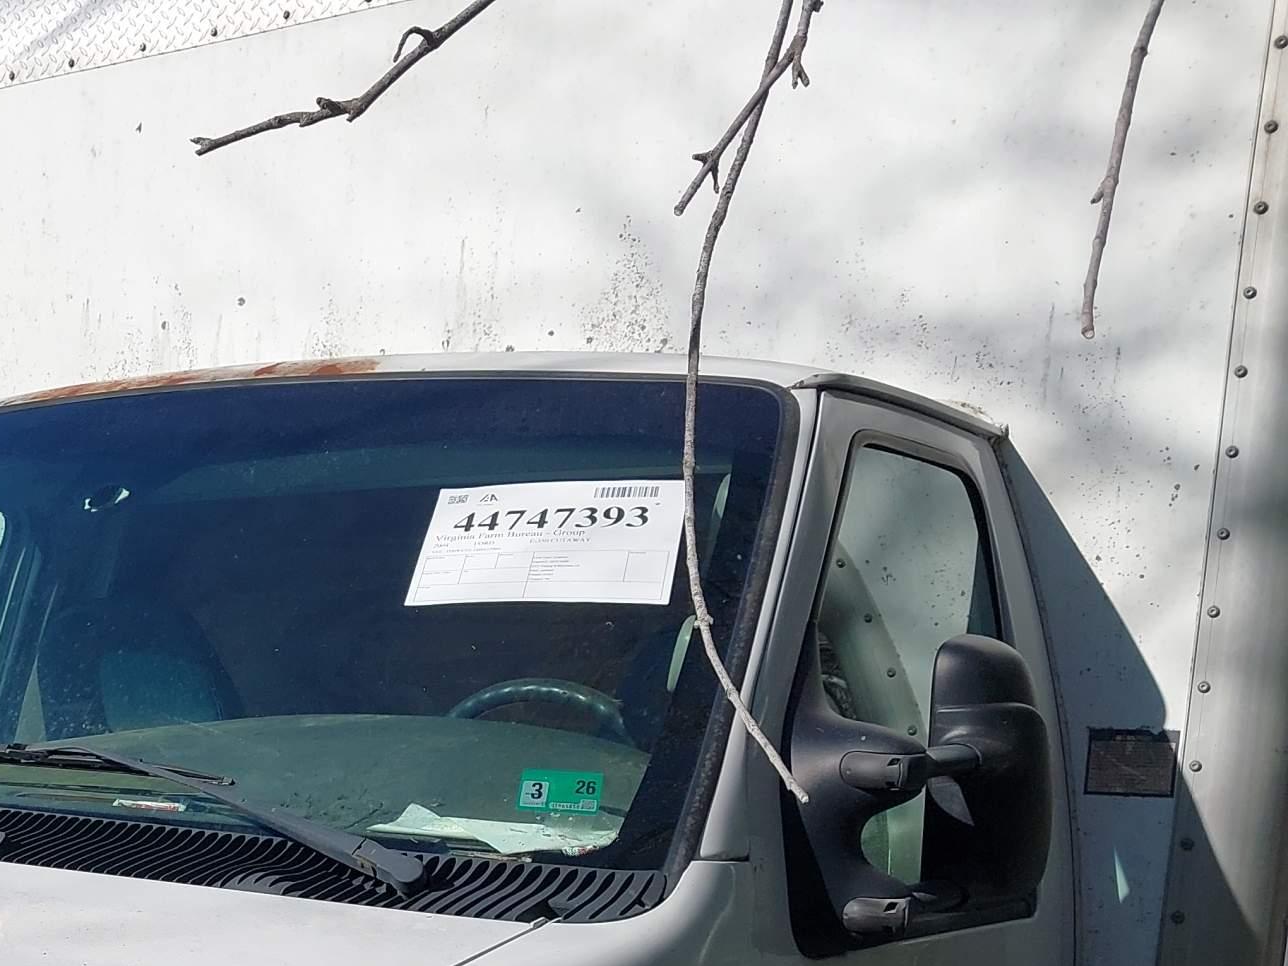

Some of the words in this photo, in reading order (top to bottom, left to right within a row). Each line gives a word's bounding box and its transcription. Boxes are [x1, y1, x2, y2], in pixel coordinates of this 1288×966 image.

[453, 505, 649, 532] 44747393
[435, 534, 475, 542] Virginia
[478, 532, 504, 540] Farm
[507, 530, 543, 538] Bureau
[553, 529, 585, 537] Group
[531, 783, 543, 799] 3
[576, 781, 596, 795] 26
